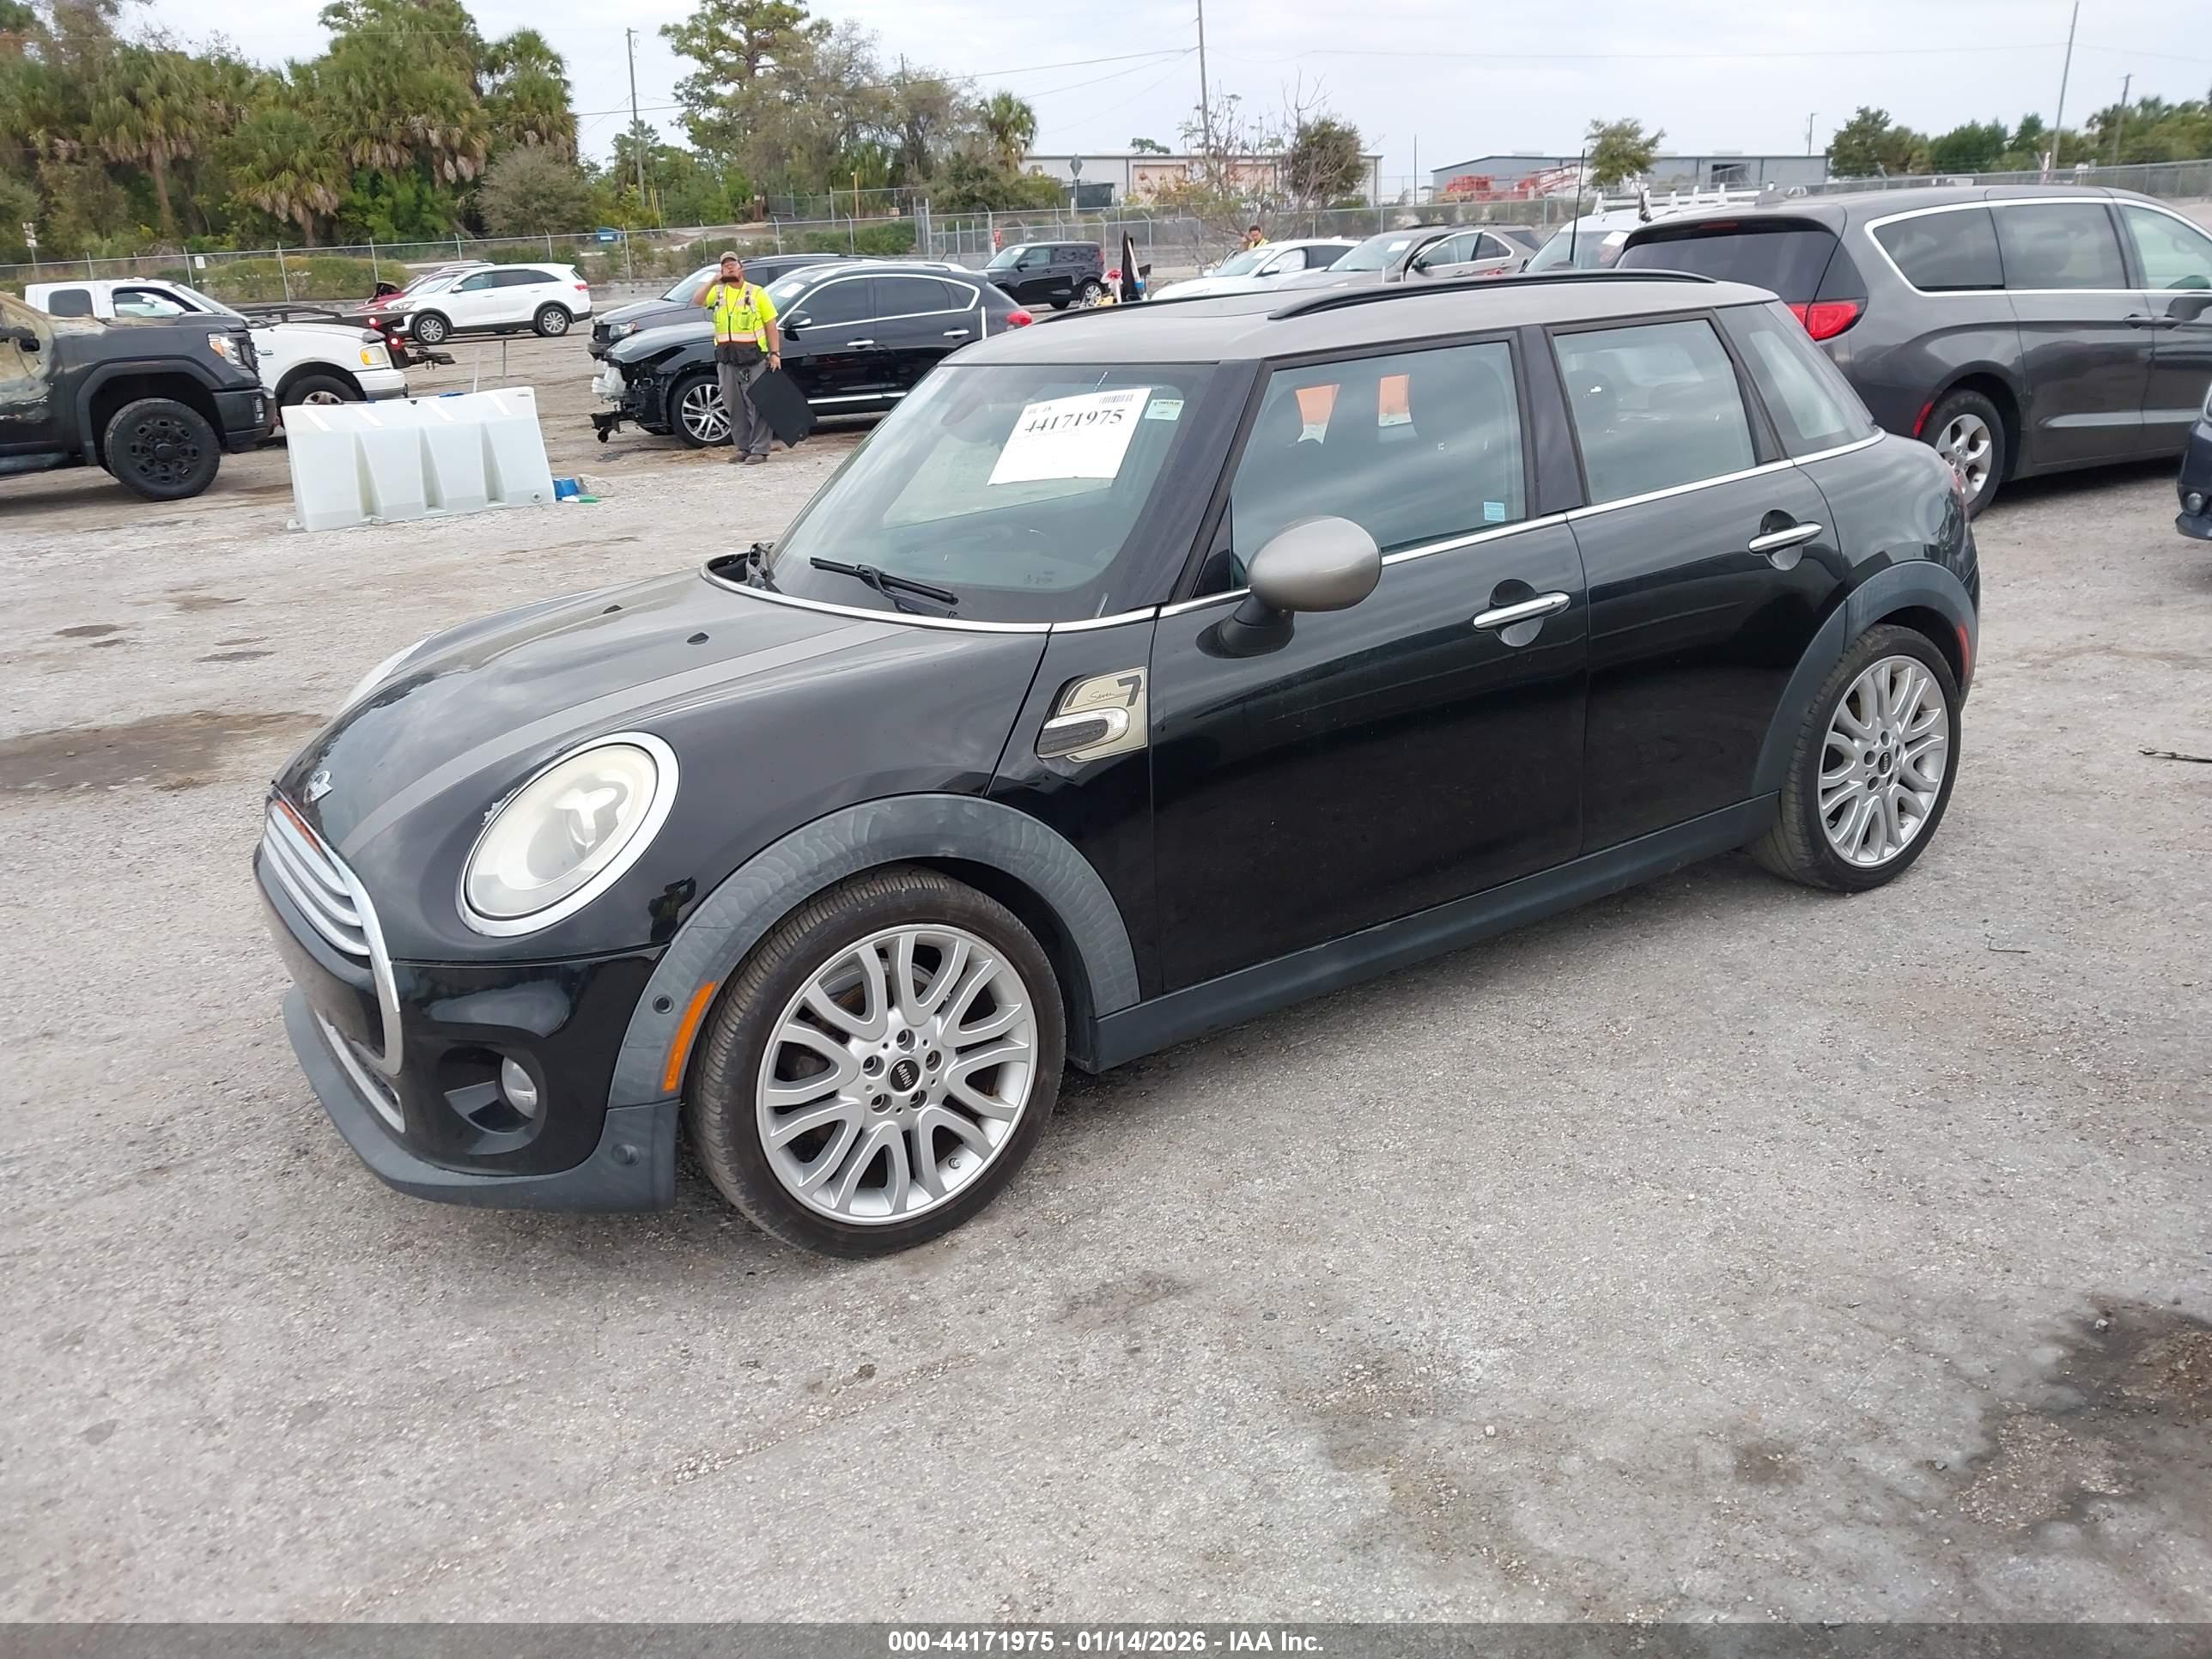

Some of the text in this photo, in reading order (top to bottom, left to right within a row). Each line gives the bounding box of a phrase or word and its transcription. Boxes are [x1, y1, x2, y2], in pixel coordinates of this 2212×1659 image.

[1024, 409, 1126, 433] 44171975
[1117, 674, 1142, 708] 7
[896, 1063, 914, 1088] MINI
